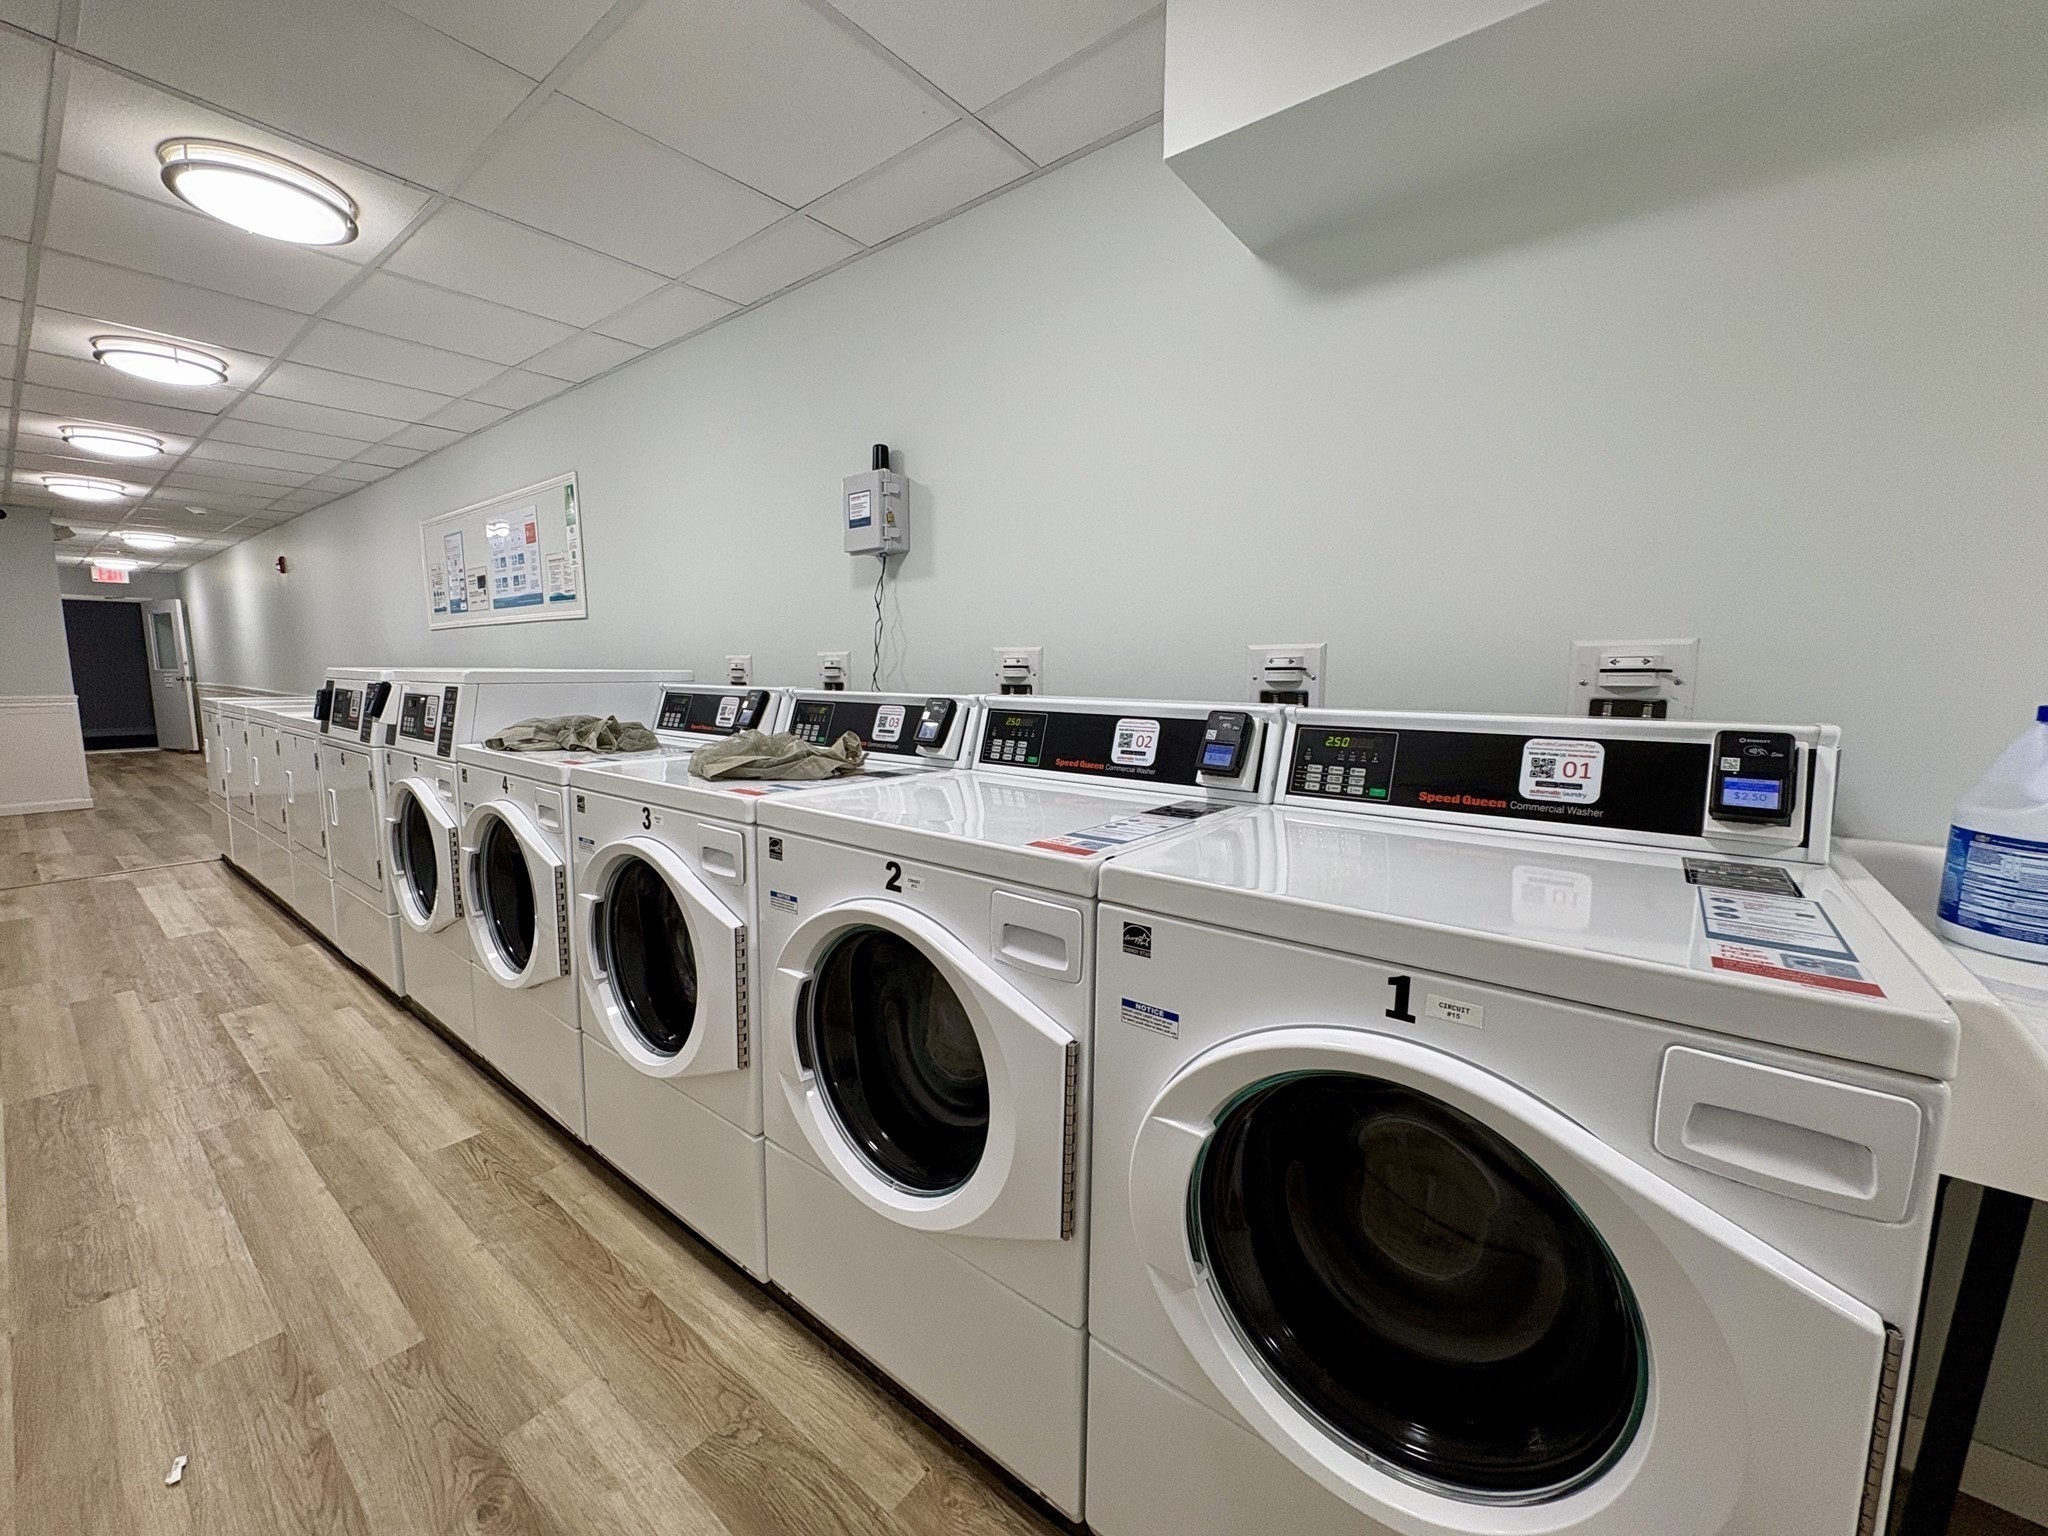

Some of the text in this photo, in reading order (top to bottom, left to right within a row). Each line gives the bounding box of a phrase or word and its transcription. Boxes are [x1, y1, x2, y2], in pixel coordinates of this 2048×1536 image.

[889, 718, 900, 728] 03
[1136, 735, 1152, 748] 02
[1325, 736, 1350, 747] 2.50
[413, 756, 419, 772] 5
[1055, 758, 1156, 775] Speed Queen Commercial Washer
[1562, 761, 1591, 780] 01
[502, 776, 509, 794] 4
[1562, 791, 1586, 799] laundry
[1734, 792, 1767, 801] $2.50
[1418, 791, 1604, 817] Speed Queen Commercial Washer
[642, 806, 651, 830] 3
[885, 861, 902, 893] 2
[1385, 975, 1416, 1024] 1
[1135, 1003, 1164, 1016] NOTICE
[1438, 1002, 1471, 1015] CIRCUIT
[1446, 1011, 1461, 1019] #15
